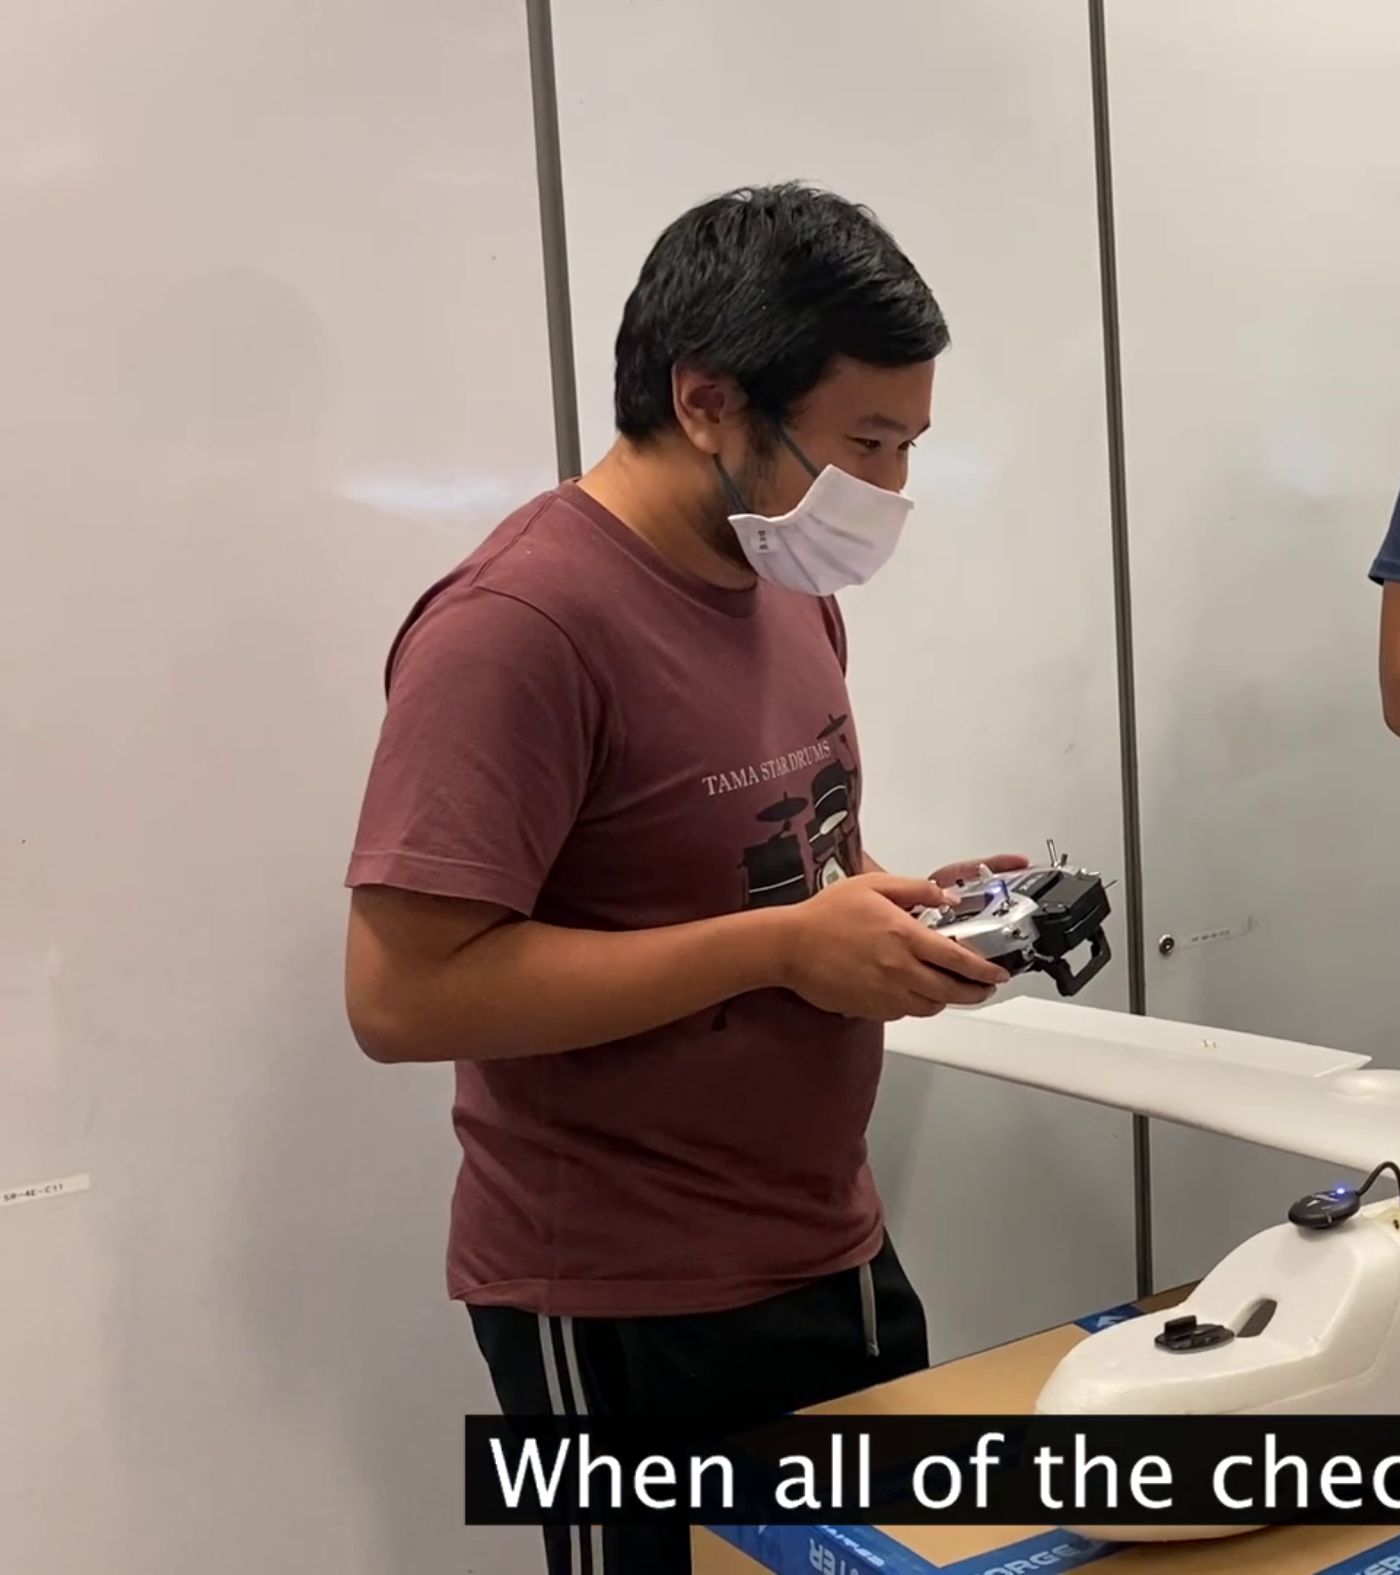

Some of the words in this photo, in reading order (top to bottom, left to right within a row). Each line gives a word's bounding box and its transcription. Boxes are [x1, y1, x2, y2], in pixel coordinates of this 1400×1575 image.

[702, 766, 760, 796] TAMA
[760, 756, 791, 781] STAR
[788, 739, 831, 772] DRUMS
